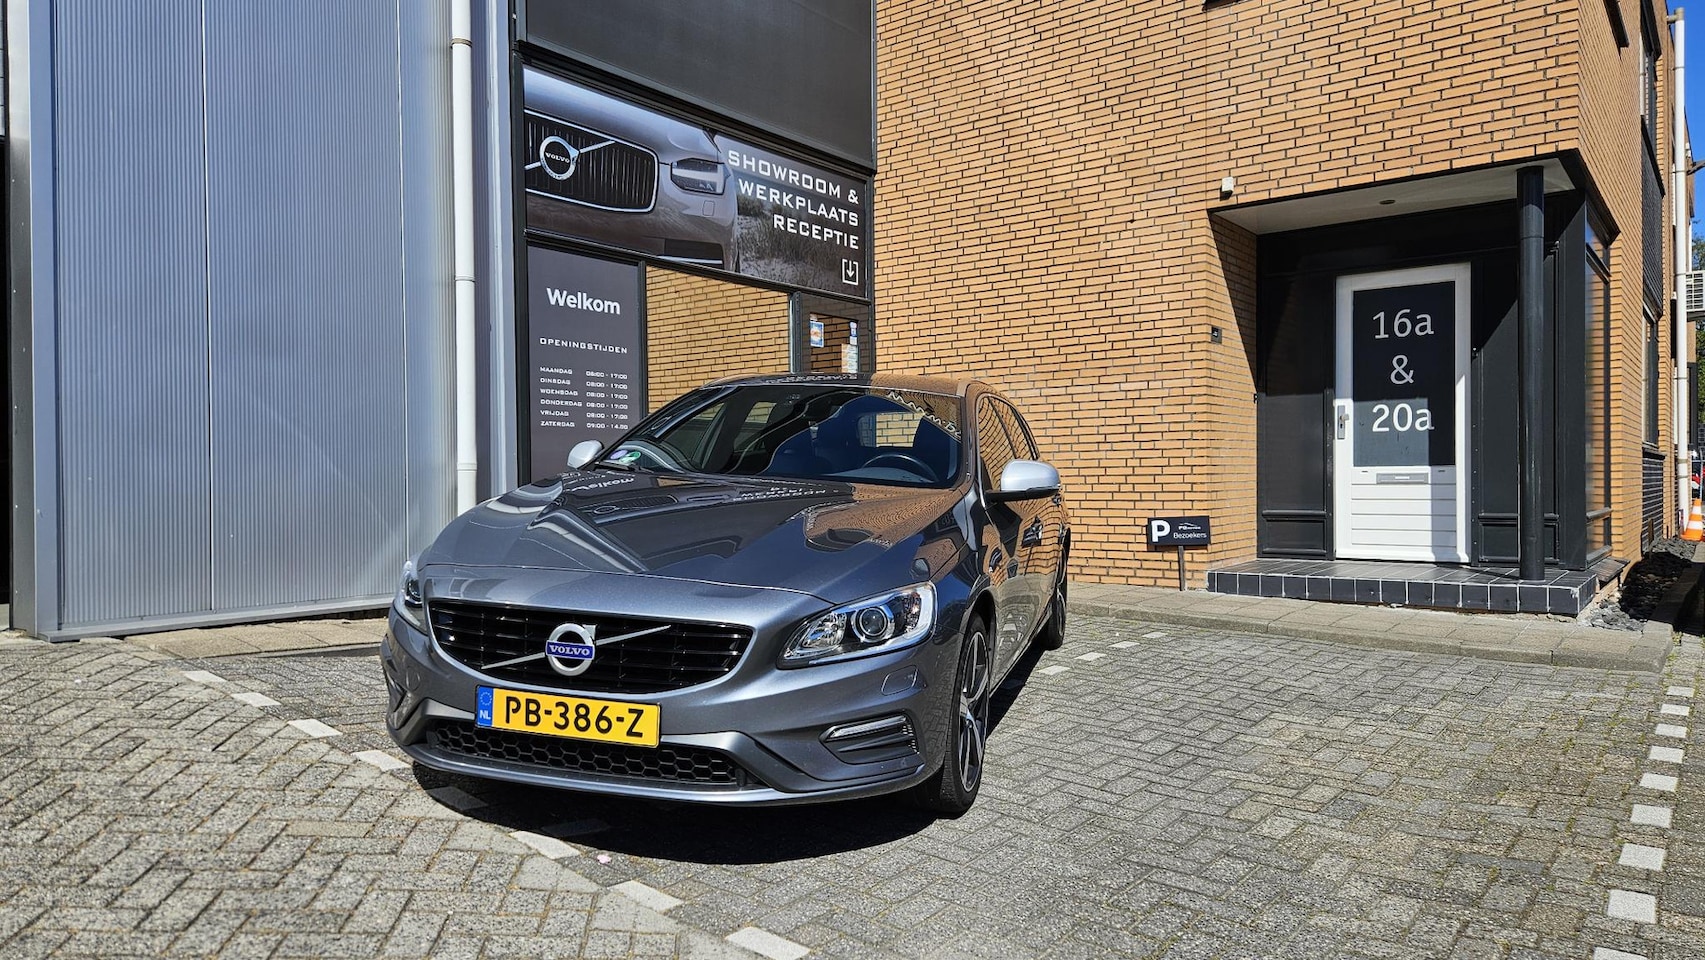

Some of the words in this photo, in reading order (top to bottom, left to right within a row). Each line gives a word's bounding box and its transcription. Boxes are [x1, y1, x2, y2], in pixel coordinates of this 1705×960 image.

[545, 151, 570, 164] VOLVO
[728, 149, 840, 199] SHOWROOM
[847, 189, 859, 205] &
[739, 178, 858, 226] WERKPLAATS
[773, 213, 859, 249] RECEPTIE
[546, 287, 621, 315] Welkom
[1372, 308, 1434, 339] 16a
[539, 337, 628, 354] OPENINGSTIJDEN
[539, 367, 573, 375] MAANDAG
[540, 377, 571, 385] DINSDAG
[1390, 354, 1414, 384] &
[540, 399, 583, 407] DONDERDAG
[1371, 403, 1434, 432] 20a
[1151, 520, 1171, 542] P
[550, 645, 590, 656] VOLVO
[479, 709, 491, 721] NL
[505, 696, 644, 738] PB-386-Z
